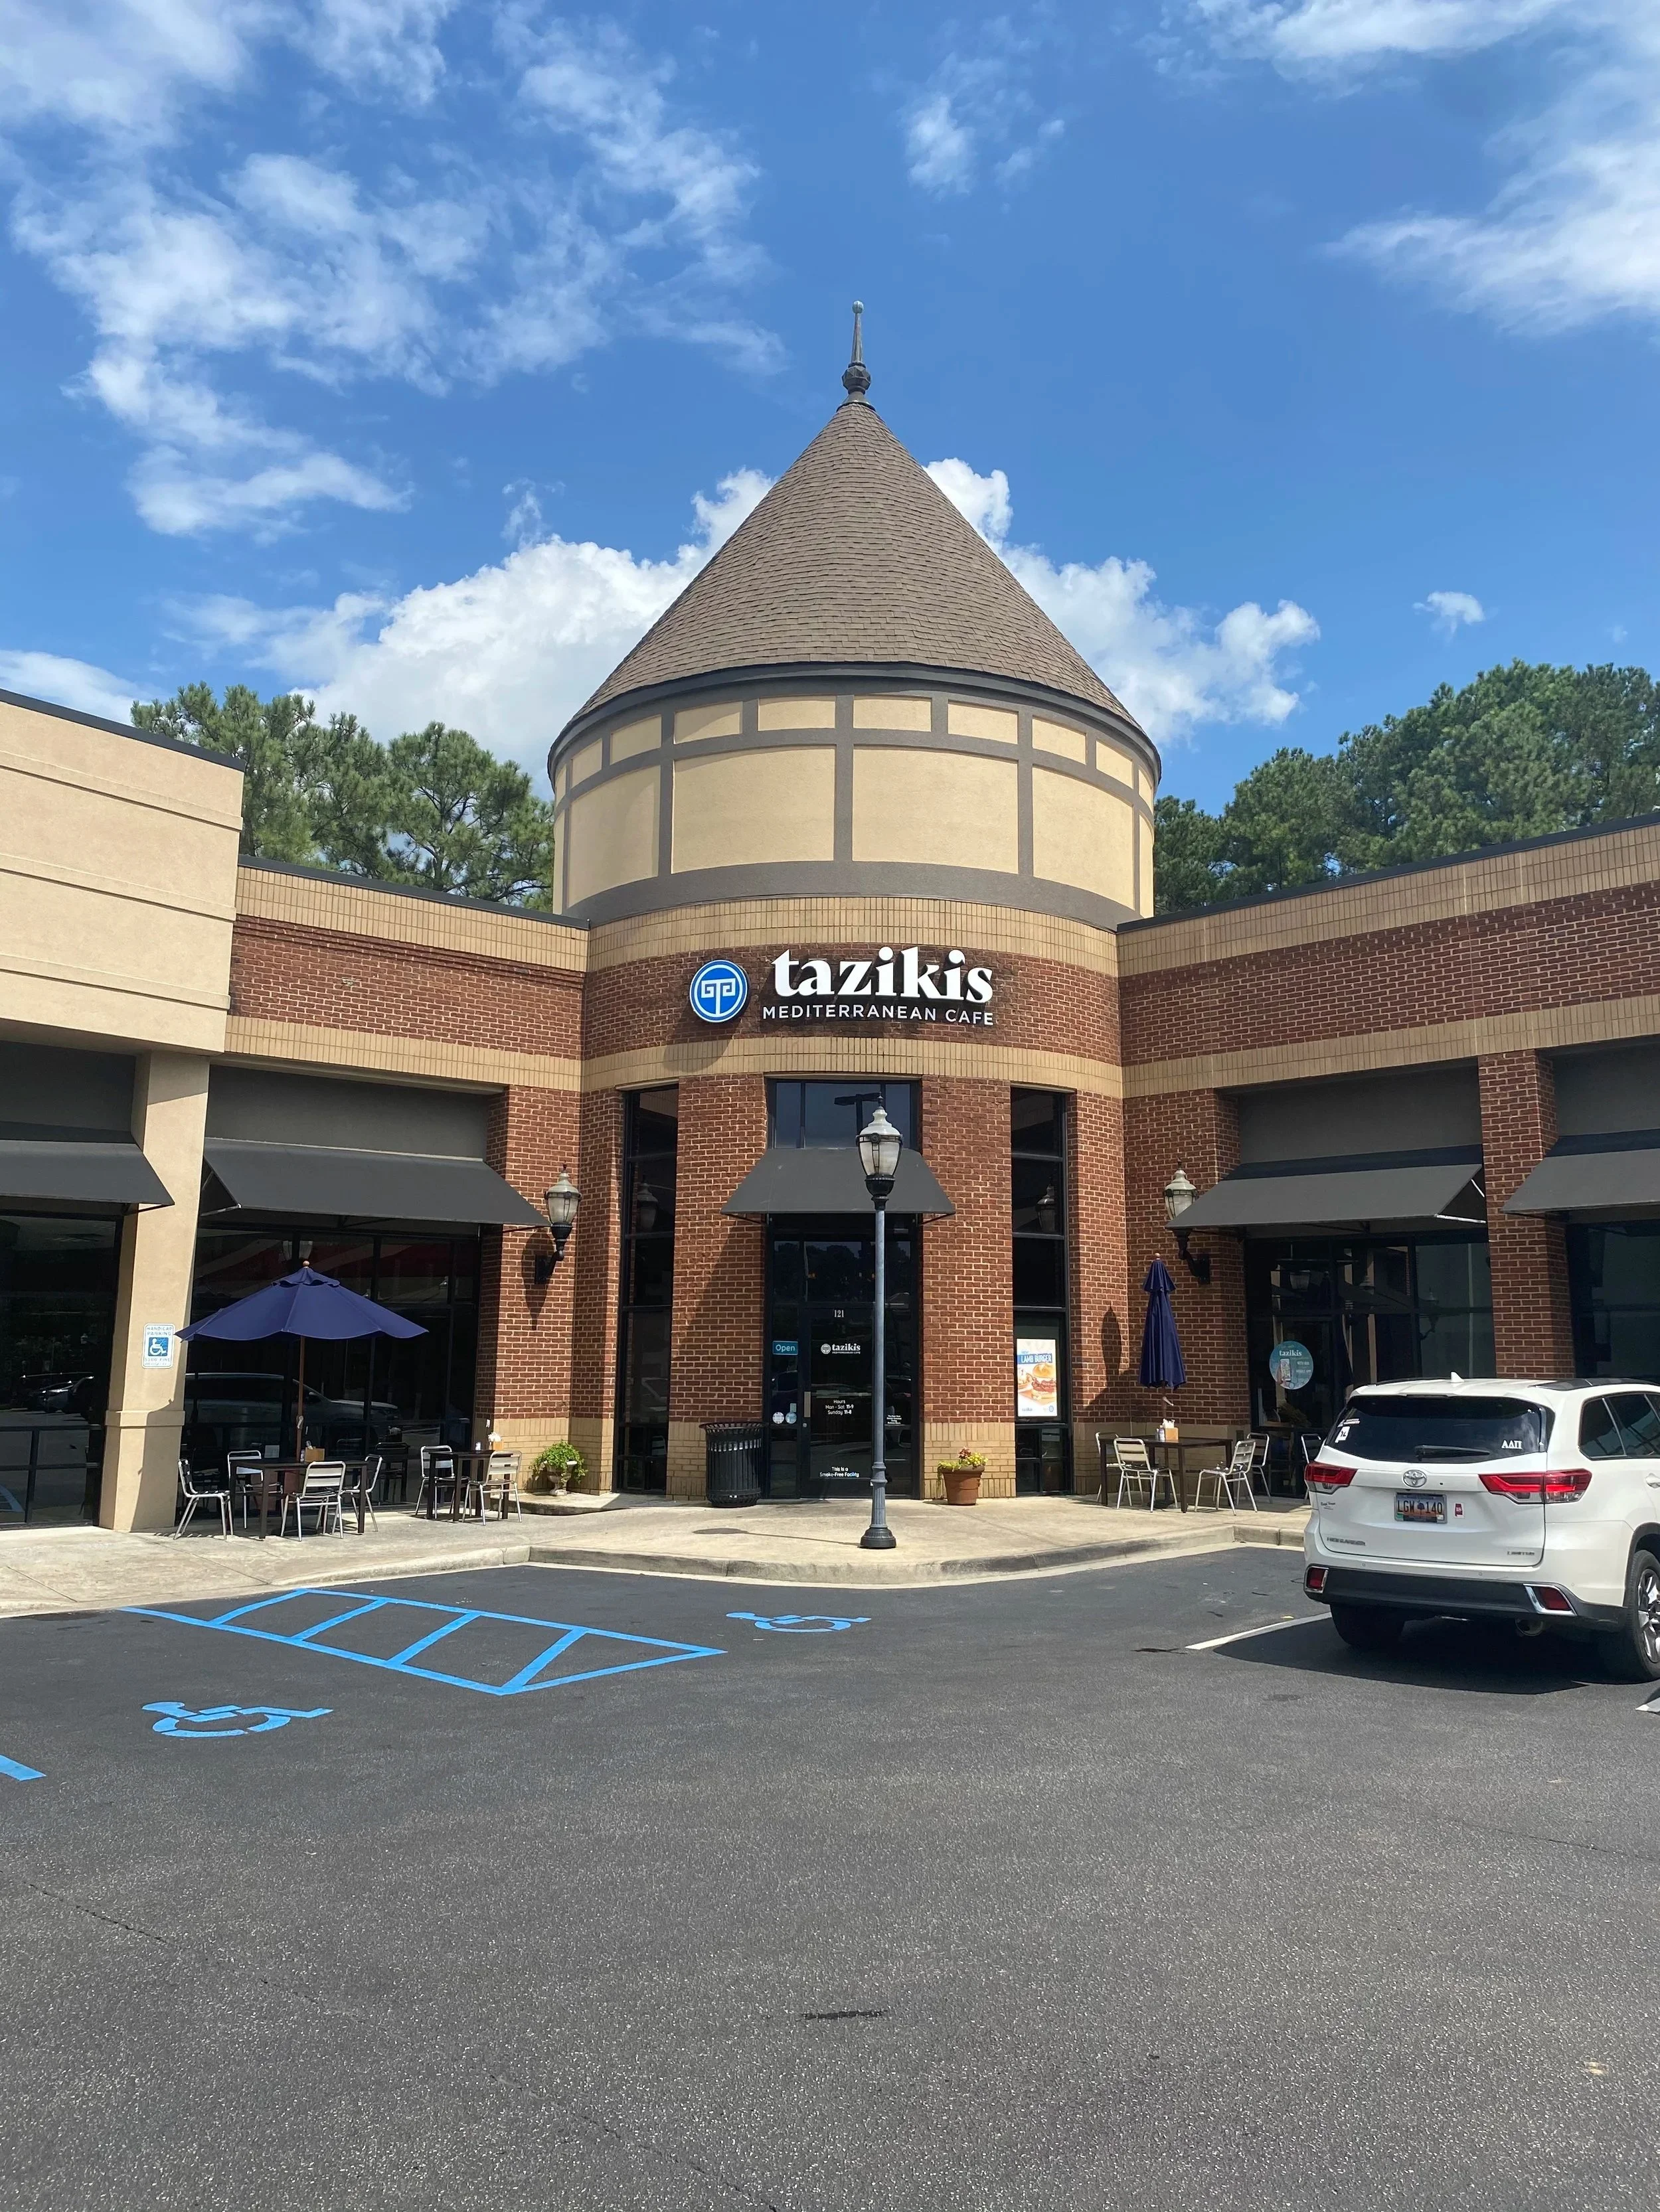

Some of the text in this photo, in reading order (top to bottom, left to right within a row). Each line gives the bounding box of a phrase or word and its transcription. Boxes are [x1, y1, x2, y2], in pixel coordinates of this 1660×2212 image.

[771, 946, 994, 1003] tazikis
[762, 1004, 994, 1026] MEDITERRANEAN CAFE
[834, 1309, 844, 1318] 121
[776, 1344, 795, 1353] Open
[1035, 1354, 1052, 1363] BURGER
[1397, 1500, 1443, 1514] LGW 140
